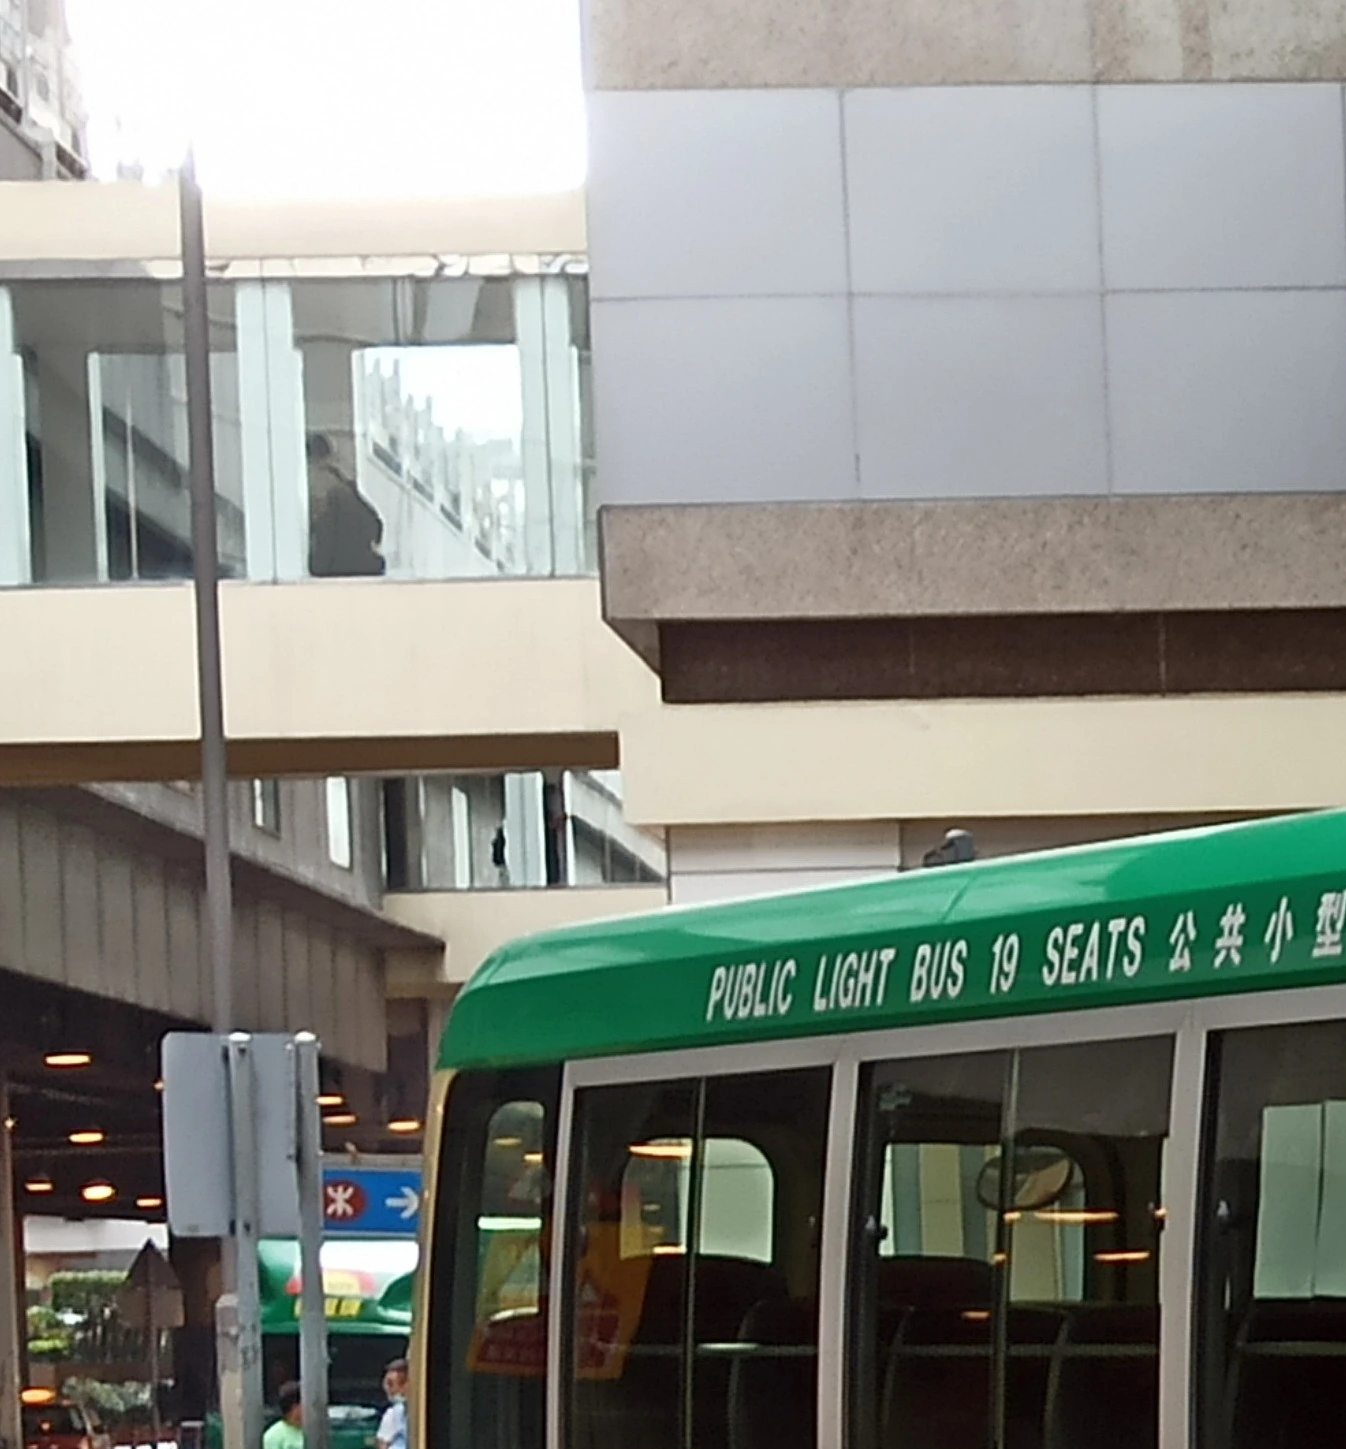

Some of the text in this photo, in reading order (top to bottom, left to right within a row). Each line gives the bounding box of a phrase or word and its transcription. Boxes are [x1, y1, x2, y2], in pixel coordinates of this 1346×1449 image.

[706, 958, 797, 1022] PUBLIC
[813, 947, 896, 1012] LIGHT
[909, 940, 968, 1003] BUS
[989, 933, 1019, 994] 19
[1042, 916, 1146, 986] SEATS
